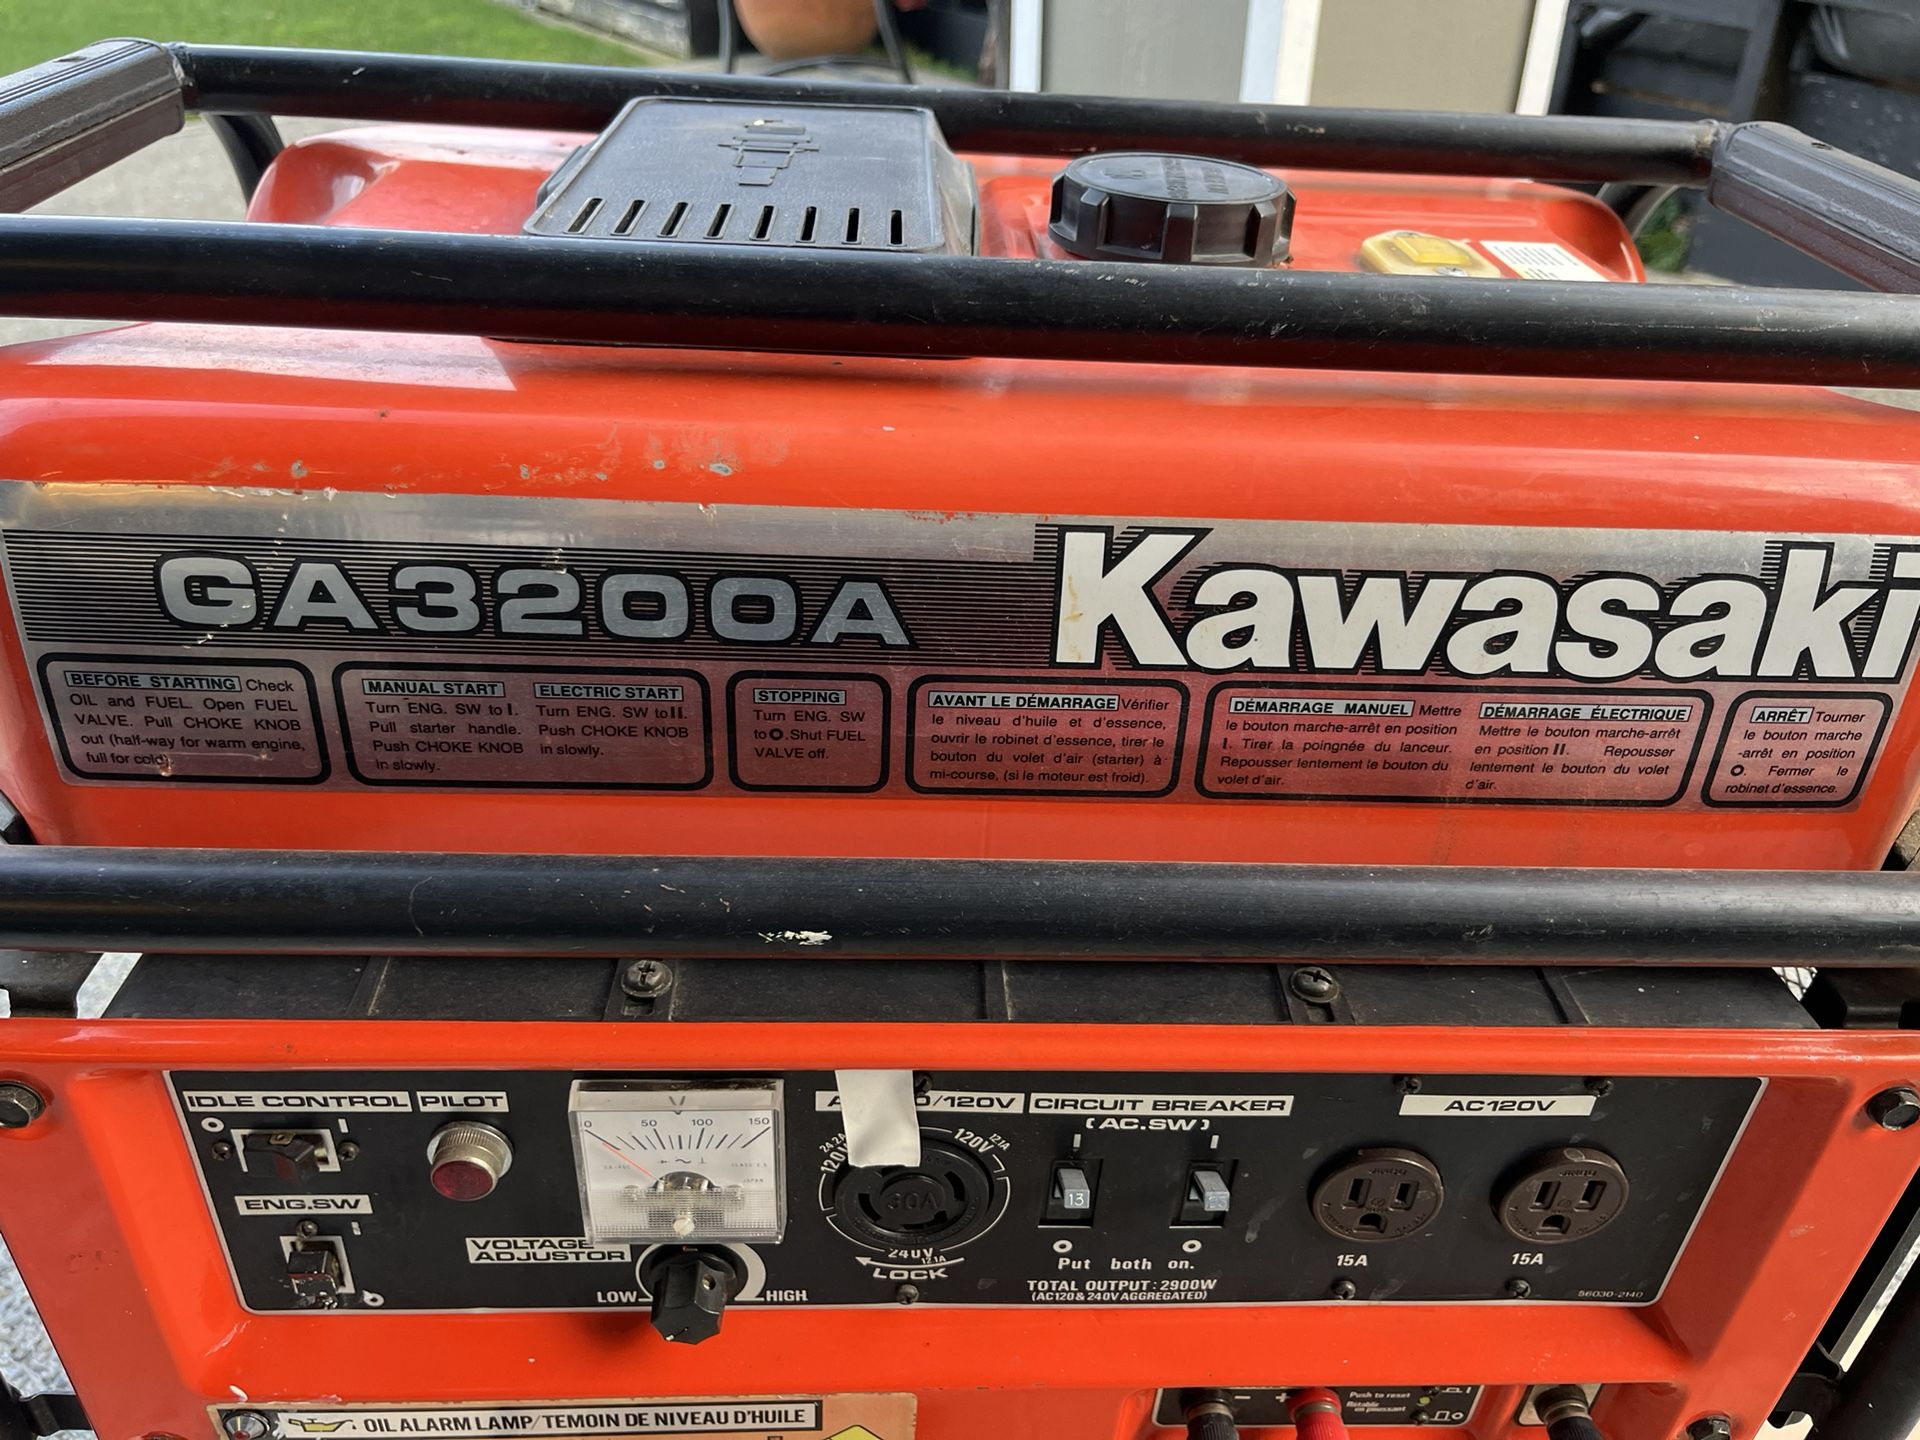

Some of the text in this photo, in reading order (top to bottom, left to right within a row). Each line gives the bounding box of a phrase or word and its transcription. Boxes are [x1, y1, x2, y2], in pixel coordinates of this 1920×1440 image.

[160, 557, 909, 645] GA3200A
[1055, 530, 1920, 679] Kawasaki
[71, 674, 294, 692] BEFORE STARTING Check
[367, 681, 498, 696] MANUAL START
[539, 684, 679, 699] ELECTRIC START
[759, 690, 840, 703] STOPPING
[70, 694, 298, 712] OIL and FUEL. Open FUEL
[933, 693, 1169, 710] AVANT LE DÉMARRAGE Vérifier
[1234, 698, 1462, 717] DÉMARRAGE MANUEL Mettre
[365, 702, 400, 715] Turn
[408, 702, 447, 716] ENG.
[456, 703, 481, 716] SW
[489, 704, 503, 716] to
[536, 705, 570, 717] Turn
[577, 705, 616, 718] ENG.
[623, 706, 649, 719] SW
[753, 709, 866, 723] Turn ENG. SW
[1483, 704, 1687, 720] DÉMARRAGE ÉLECTRIQUE
[1755, 709, 1865, 723] ARRÊT Tourner
[74, 714, 301, 731] VALVE. Pull CHOKE KNOB
[370, 721, 521, 736] Pull starter handle.
[933, 714, 1166, 730] le niveau d'huile et d'essence,
[538, 724, 689, 738] Push CHOKE KNOB
[1479, 725, 1681, 739] Mettre le bouton marche-arrêt
[1744, 730, 1862, 741] le bouton marche
[81, 734, 305, 752] out (half-way for warm engine,
[373, 740, 524, 755] Push CHOKE KNOB
[931, 733, 1164, 748] ouvrir le robinet d'essence, tirer le
[86, 752, 108, 763] full
[110, 753, 130, 765] for
[755, 747, 829, 759] VALVE off.
[1475, 745, 1492, 754] en
[1497, 744, 1548, 757] position
[1603, 745, 1675, 759] Repousser
[1738, 748, 1855, 761] -arrêt en position
[376, 759, 441, 773] in slowly.
[931, 751, 1161, 767] bouton du volet d'air (starter) à
[1725, 784, 1838, 794] robinet d'essence.
[188, 1096, 408, 1108] IDLE CONTROL
[421, 1096, 504, 1107] PILOT
[669, 1096, 686, 1114] V
[1034, 1098, 1286, 1111] CIRCUIT BREAKER
[1444, 1100, 1556, 1112] AC120V
[584, 1117, 770, 1128] 0 50 100 150
[955, 1128, 994, 1152] 120V
[245, 1199, 361, 1210] ENG.SW
[1068, 1194, 1084, 1206] 13
[471, 1239, 594, 1249] VOLTAGE
[473, 1251, 625, 1262] ADJUSTOR
[1336, 1255, 1368, 1267] 15A
[1511, 1253, 1544, 1266] 15A
[1058, 1258, 1195, 1270] Put both on.
[873, 1268, 948, 1279] LOCK
[1027, 1280, 1079, 1291] TOTAL
[597, 1291, 637, 1303] LOW
[766, 1289, 808, 1301] HIGH
[364, 1419, 397, 1433] OIL
[400, 1417, 472, 1432] ALARM
[626, 1413, 649, 1427] DE
[654, 1411, 729, 1426] NIVEAU
[734, 1409, 805, 1424] D'HUILE
